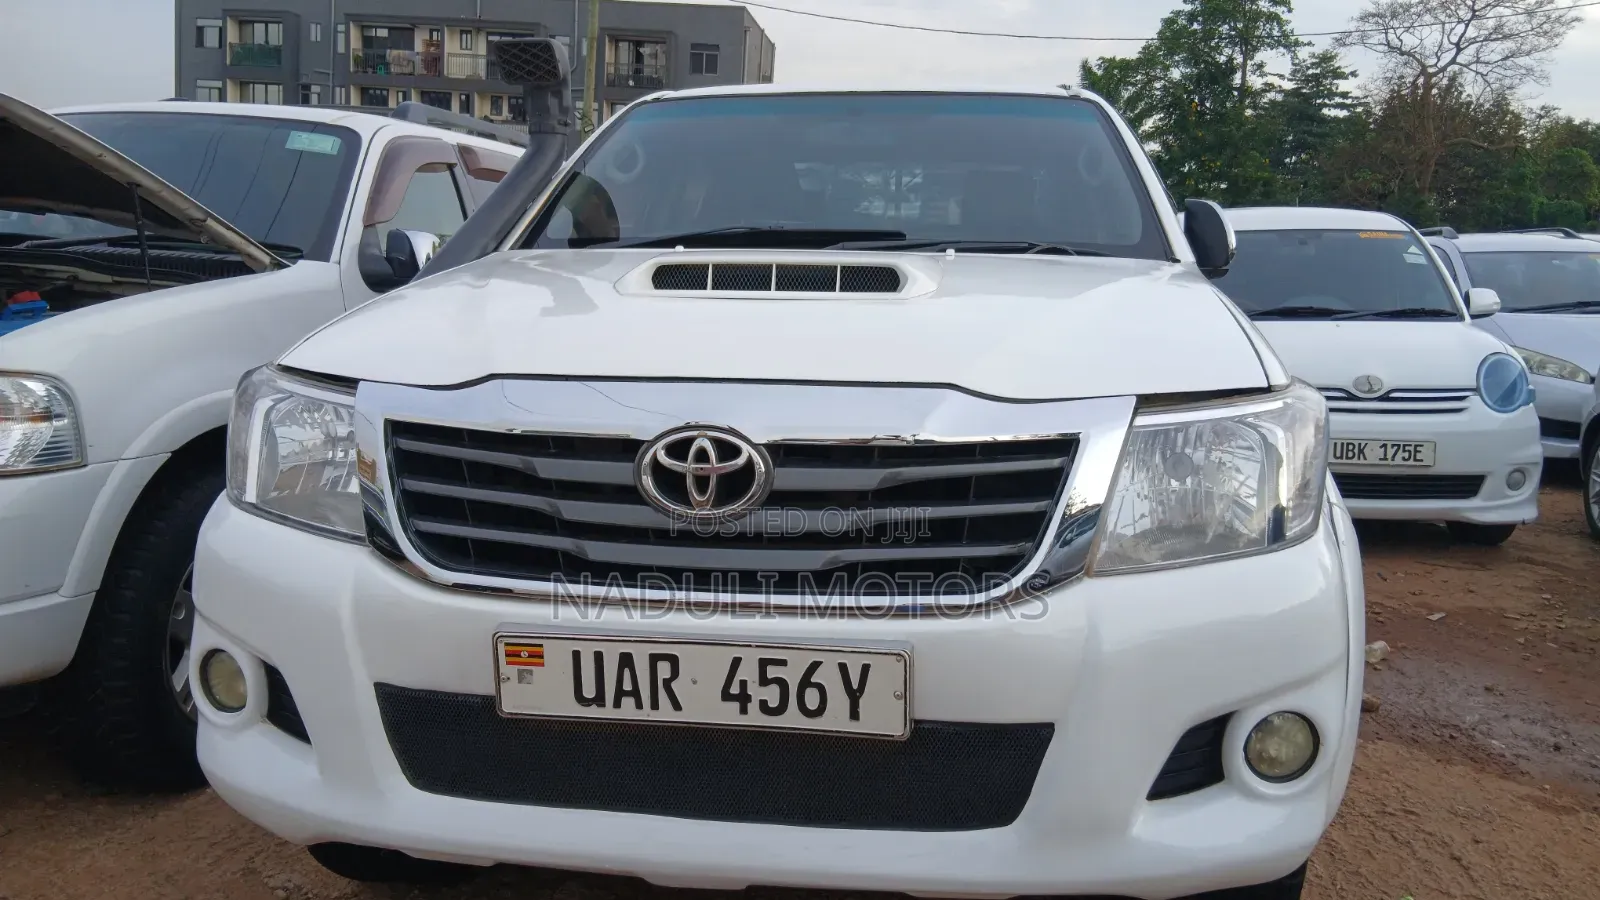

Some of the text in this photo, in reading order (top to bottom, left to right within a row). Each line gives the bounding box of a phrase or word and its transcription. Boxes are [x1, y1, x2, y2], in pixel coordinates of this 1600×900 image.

[1333, 442, 1425, 462] UBK 175E
[571, 649, 871, 721] UAR 456Y
